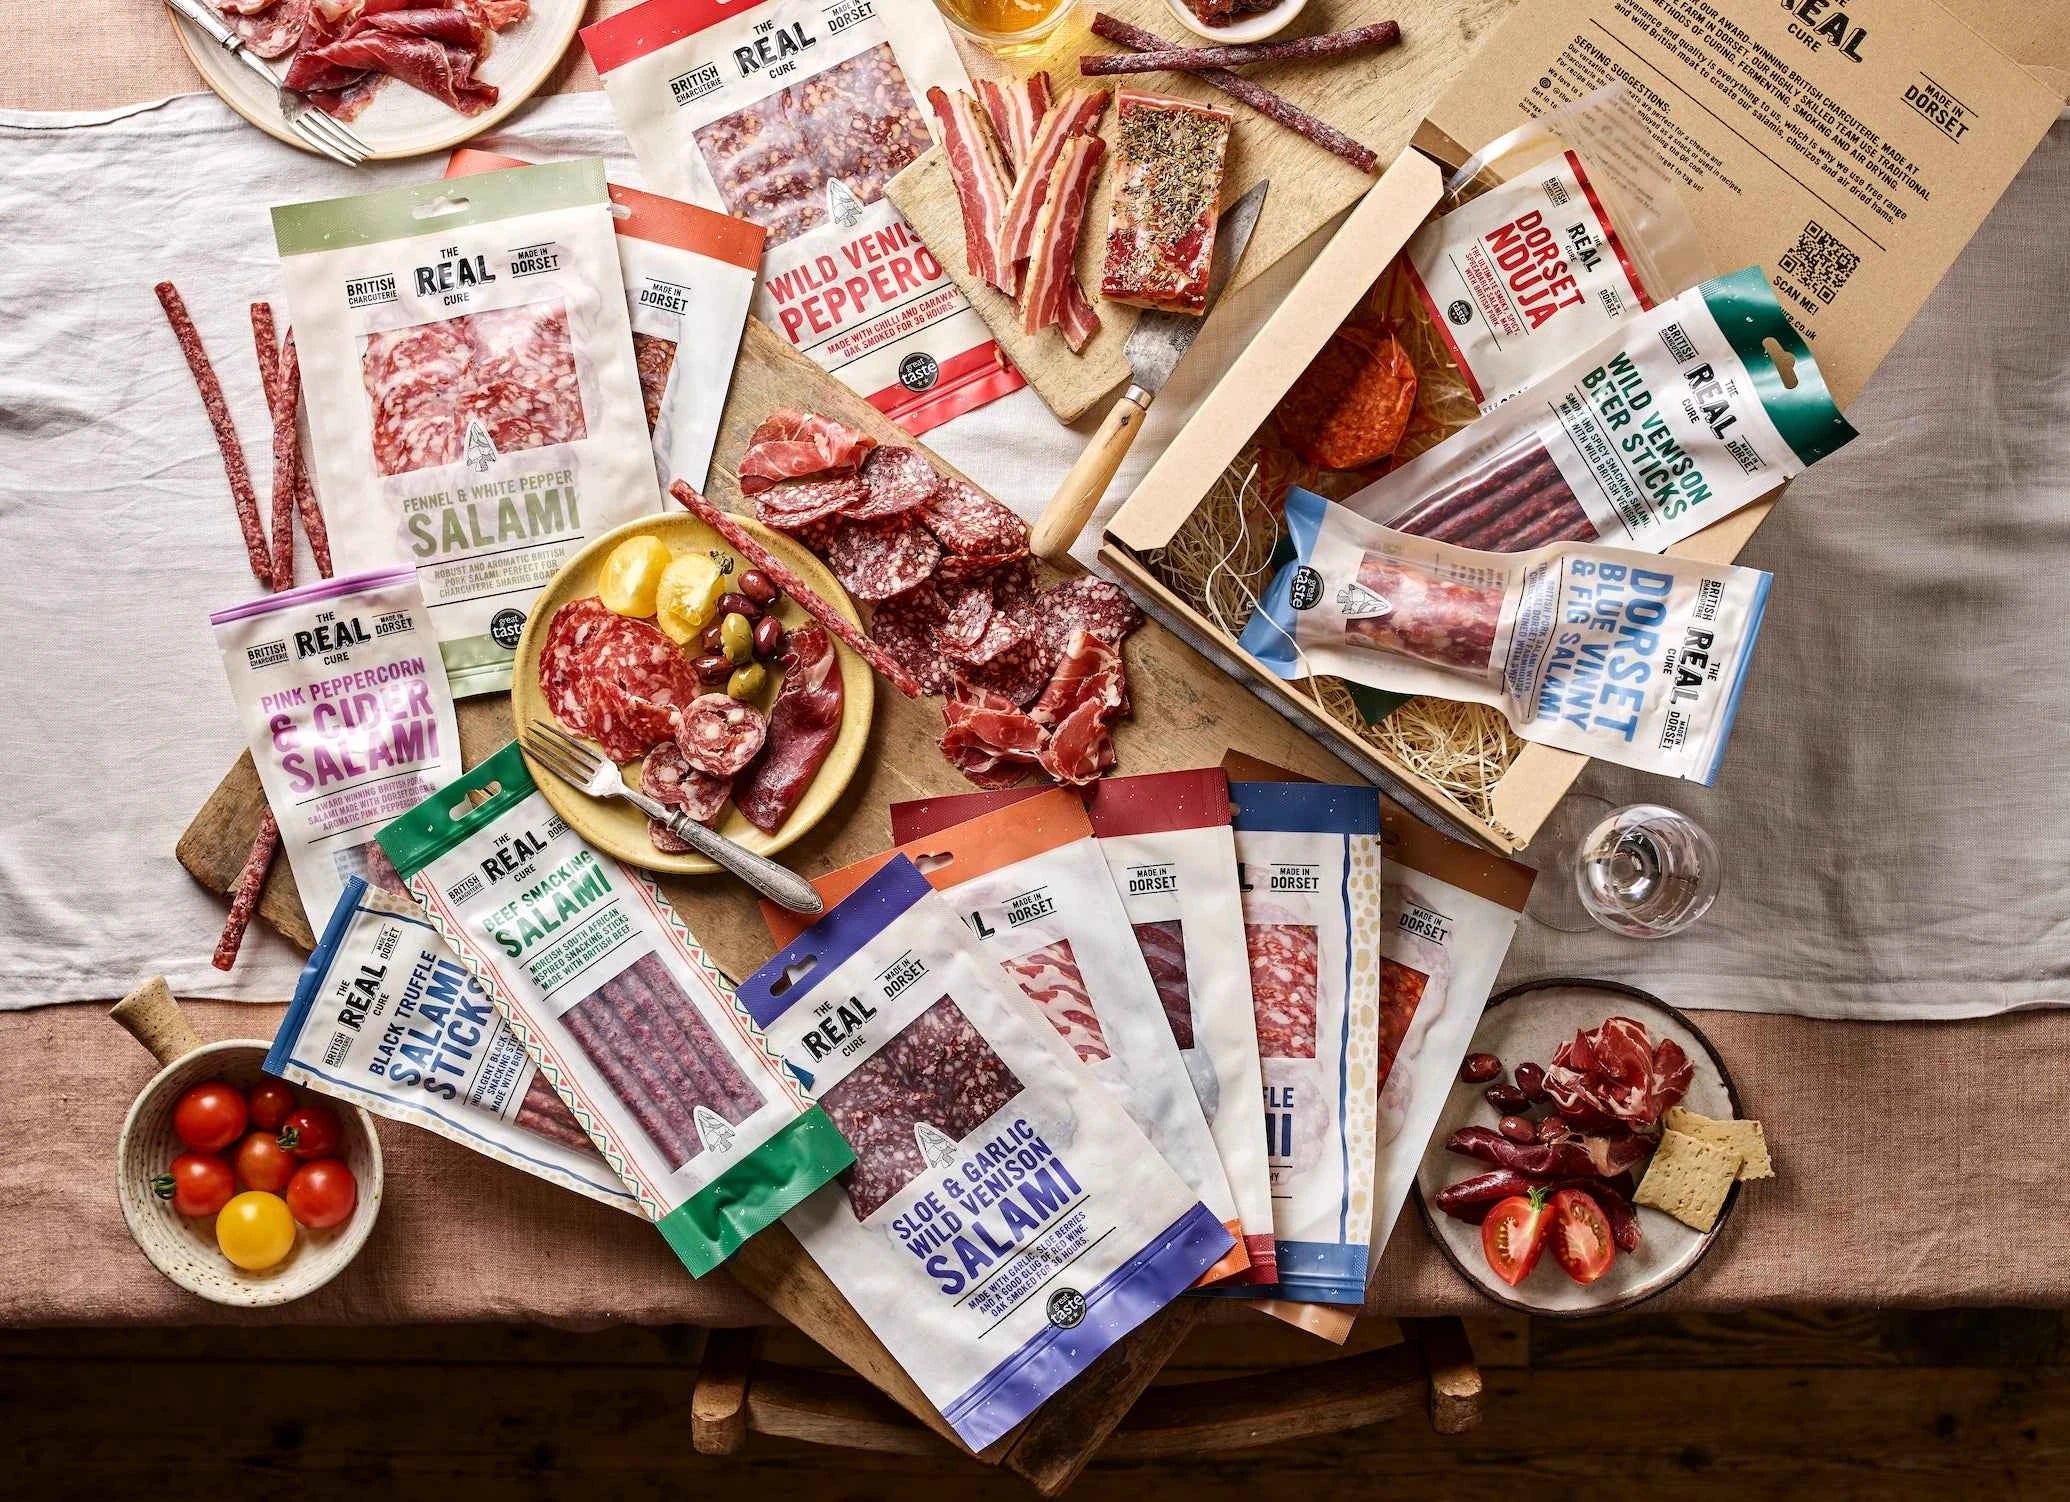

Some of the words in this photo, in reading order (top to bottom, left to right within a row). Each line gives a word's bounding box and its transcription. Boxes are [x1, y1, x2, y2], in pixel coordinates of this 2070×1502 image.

[754, 19, 774, 36] THE
[828, 2, 873, 31] DORSET
[732, 22, 816, 79] REAL
[1787, 23, 1822, 53] CURE
[671, 66, 719, 94] BRITISH
[769, 61, 796, 79] CURE
[1574, 36, 1611, 66] SERVING
[1611, 63, 1671, 113] SUGGESTIONS:
[676, 78, 722, 103] CHARCUTERIE
[1680, 1, 1706, 24] FARM
[1705, 21, 1716, 32] IN
[1751, 56, 1770, 74] OUR
[1769, 70, 1801, 97] HIGHLY
[1801, 95, 1835, 125] SKILLED
[1836, 121, 1860, 144] TEAM
[1860, 140, 1877, 157] USE
[1879, 155, 1931, 201] TRADITIONAL
[1700, 2, 1719, 19] OUR
[1718, 16, 1789, 74] AWARD-WINNING
[1789, 71, 1823, 100] BRITISH
[1881, 143, 1906, 166] MADE
[1906, 163, 1919, 175] AT
[1925, 84, 1951, 109] MADE
[1952, 105, 1963, 118] IN
[1904, 85, 1969, 139] DORSET
[1548, 177, 1567, 205] BRITISH
[440, 247, 459, 258] THE
[518, 249, 538, 260] MADE
[539, 248, 548, 257] IN
[1515, 210, 1585, 308] DORSET
[1565, 245, 1578, 262] CURE
[1566, 223, 1601, 273] REAL
[414, 255, 496, 297] REAL
[512, 254, 558, 275] DORSET
[766, 255, 838, 304] WILD
[1485, 223, 1561, 329] NDUJA
[347, 277, 396, 299] BRITISH
[348, 289, 397, 304] CHARCUTERIE
[444, 292, 470, 306] CURE
[641, 290, 688, 312] DORSET
[653, 283, 671, 294] MADE
[673, 288, 681, 296] IN
[1600, 289, 1619, 318] DORSET
[1773, 276, 1800, 300] SCAN
[1800, 298, 1819, 316] ME!
[828, 338, 851, 354] MADE
[852, 327, 872, 343] WITH
[874, 314, 899, 332] CHILLI
[901, 307, 918, 320] AND
[844, 346, 862, 358] OAK
[862, 328, 895, 349] SMOKED
[897, 321, 913, 333] FOR
[914, 315, 924, 325] 36
[1667, 325, 1695, 360] BRITISH
[901, 362, 937, 385] taste
[906, 359, 924, 372] great
[1684, 362, 1737, 439] REAL
[1724, 379, 1738, 398] THE
[1682, 399, 1699, 424] CURE
[1582, 366, 1631, 431] BEER
[1622, 434, 1688, 520] STICKS
[1608, 352, 1652, 411] WILD
[1641, 411, 1712, 506] VENISON
[1726, 441, 1758, 473] DORSET
[403, 492, 454, 513] FENNEL
[457, 489, 466, 502] &
[472, 479, 516, 499] WHITE
[520, 470, 573, 491] PEPPER
[408, 486, 581, 558] SALAMI
[1571, 559, 1595, 576] &
[1292, 568, 1311, 609] taste
[1306, 579, 1318, 602] great
[1589, 562, 1627, 633] BLUE
[1702, 581, 1722, 620] BRITISH
[316, 612, 335, 623] THE
[499, 615, 518, 627] great
[1566, 586, 1592, 624] FIG
[293, 618, 371, 660] REAL
[376, 618, 413, 635] DORSET
[248, 642, 286, 659] BRITISH
[324, 652, 350, 666] CURE
[1594, 568, 1674, 743] DORSET
[1663, 649, 1677, 675] CURE
[1670, 627, 1714, 705] REAL
[261, 687, 306, 714] PINK
[309, 657, 425, 701] PEPPERCORN
[1537, 633, 1581, 721] SALAMI
[1563, 643, 1608, 732] VINNY
[1708, 662, 1720, 681] THE
[1663, 712, 1680, 751] DORSET
[282, 719, 440, 793] SALAMI
[494, 833, 511, 847] THE
[480, 830, 547, 885] REAL
[514, 864, 536, 882] CURE
[1137, 869, 1157, 878] MADE
[448, 875, 479, 899] BRITISH
[482, 901, 520, 932] BEEF
[522, 850, 594, 906] SNACKING
[1129, 875, 1176, 892] DORSET
[1271, 877, 1319, 889] DORSET
[494, 864, 612, 958] SALAMI
[1008, 897, 1054, 924] DORSET
[1012, 897, 1033, 909] MADE
[1034, 893, 1041, 901] IN
[1412, 909, 1433, 922] MADE
[1434, 916, 1442, 925] IN
[529, 945, 562, 972] MOREISH
[563, 931, 589, 950] SOUTH
[589, 908, 620, 932] AFRICAN
[1400, 913, 1447, 941] DORSET
[381, 927, 401, 960] DORSET
[532, 959, 565, 984] INSPIRED
[566, 933, 602, 960] SNACKING
[601, 915, 629, 937] STICKS
[541, 976, 560, 991] MADE
[563, 963, 583, 979] WITH
[584, 940, 614, 966] BRITISH
[883, 959, 927, 998] DORSET
[884, 964, 902, 982] MADE
[901, 958, 911, 969] IN
[336, 980, 350, 997] THE
[339, 964, 387, 1032] REAL
[373, 993, 389, 1016] CURE
[369, 1022, 405, 1075] BLACK
[395, 950, 436, 1018] TRUFFLE
[389, 960, 468, 1086] SALAMI
[813, 1001, 833, 1018] THE
[801, 996, 877, 1063] REAL
[326, 1033, 346, 1066] BRITISH
[842, 1035, 867, 1057] CURE
[892, 1191, 946, 1240] SLOE
[942, 1178, 965, 1198] &
[961, 1119, 1034, 1182] GARLIC
[907, 1210, 963, 1260] WILD
[960, 1137, 1053, 1216] VENISON
[926, 1157, 1082, 1295] SALAMI
[1050, 1292, 1084, 1324] taste
[1053, 1292, 1070, 1311] great
